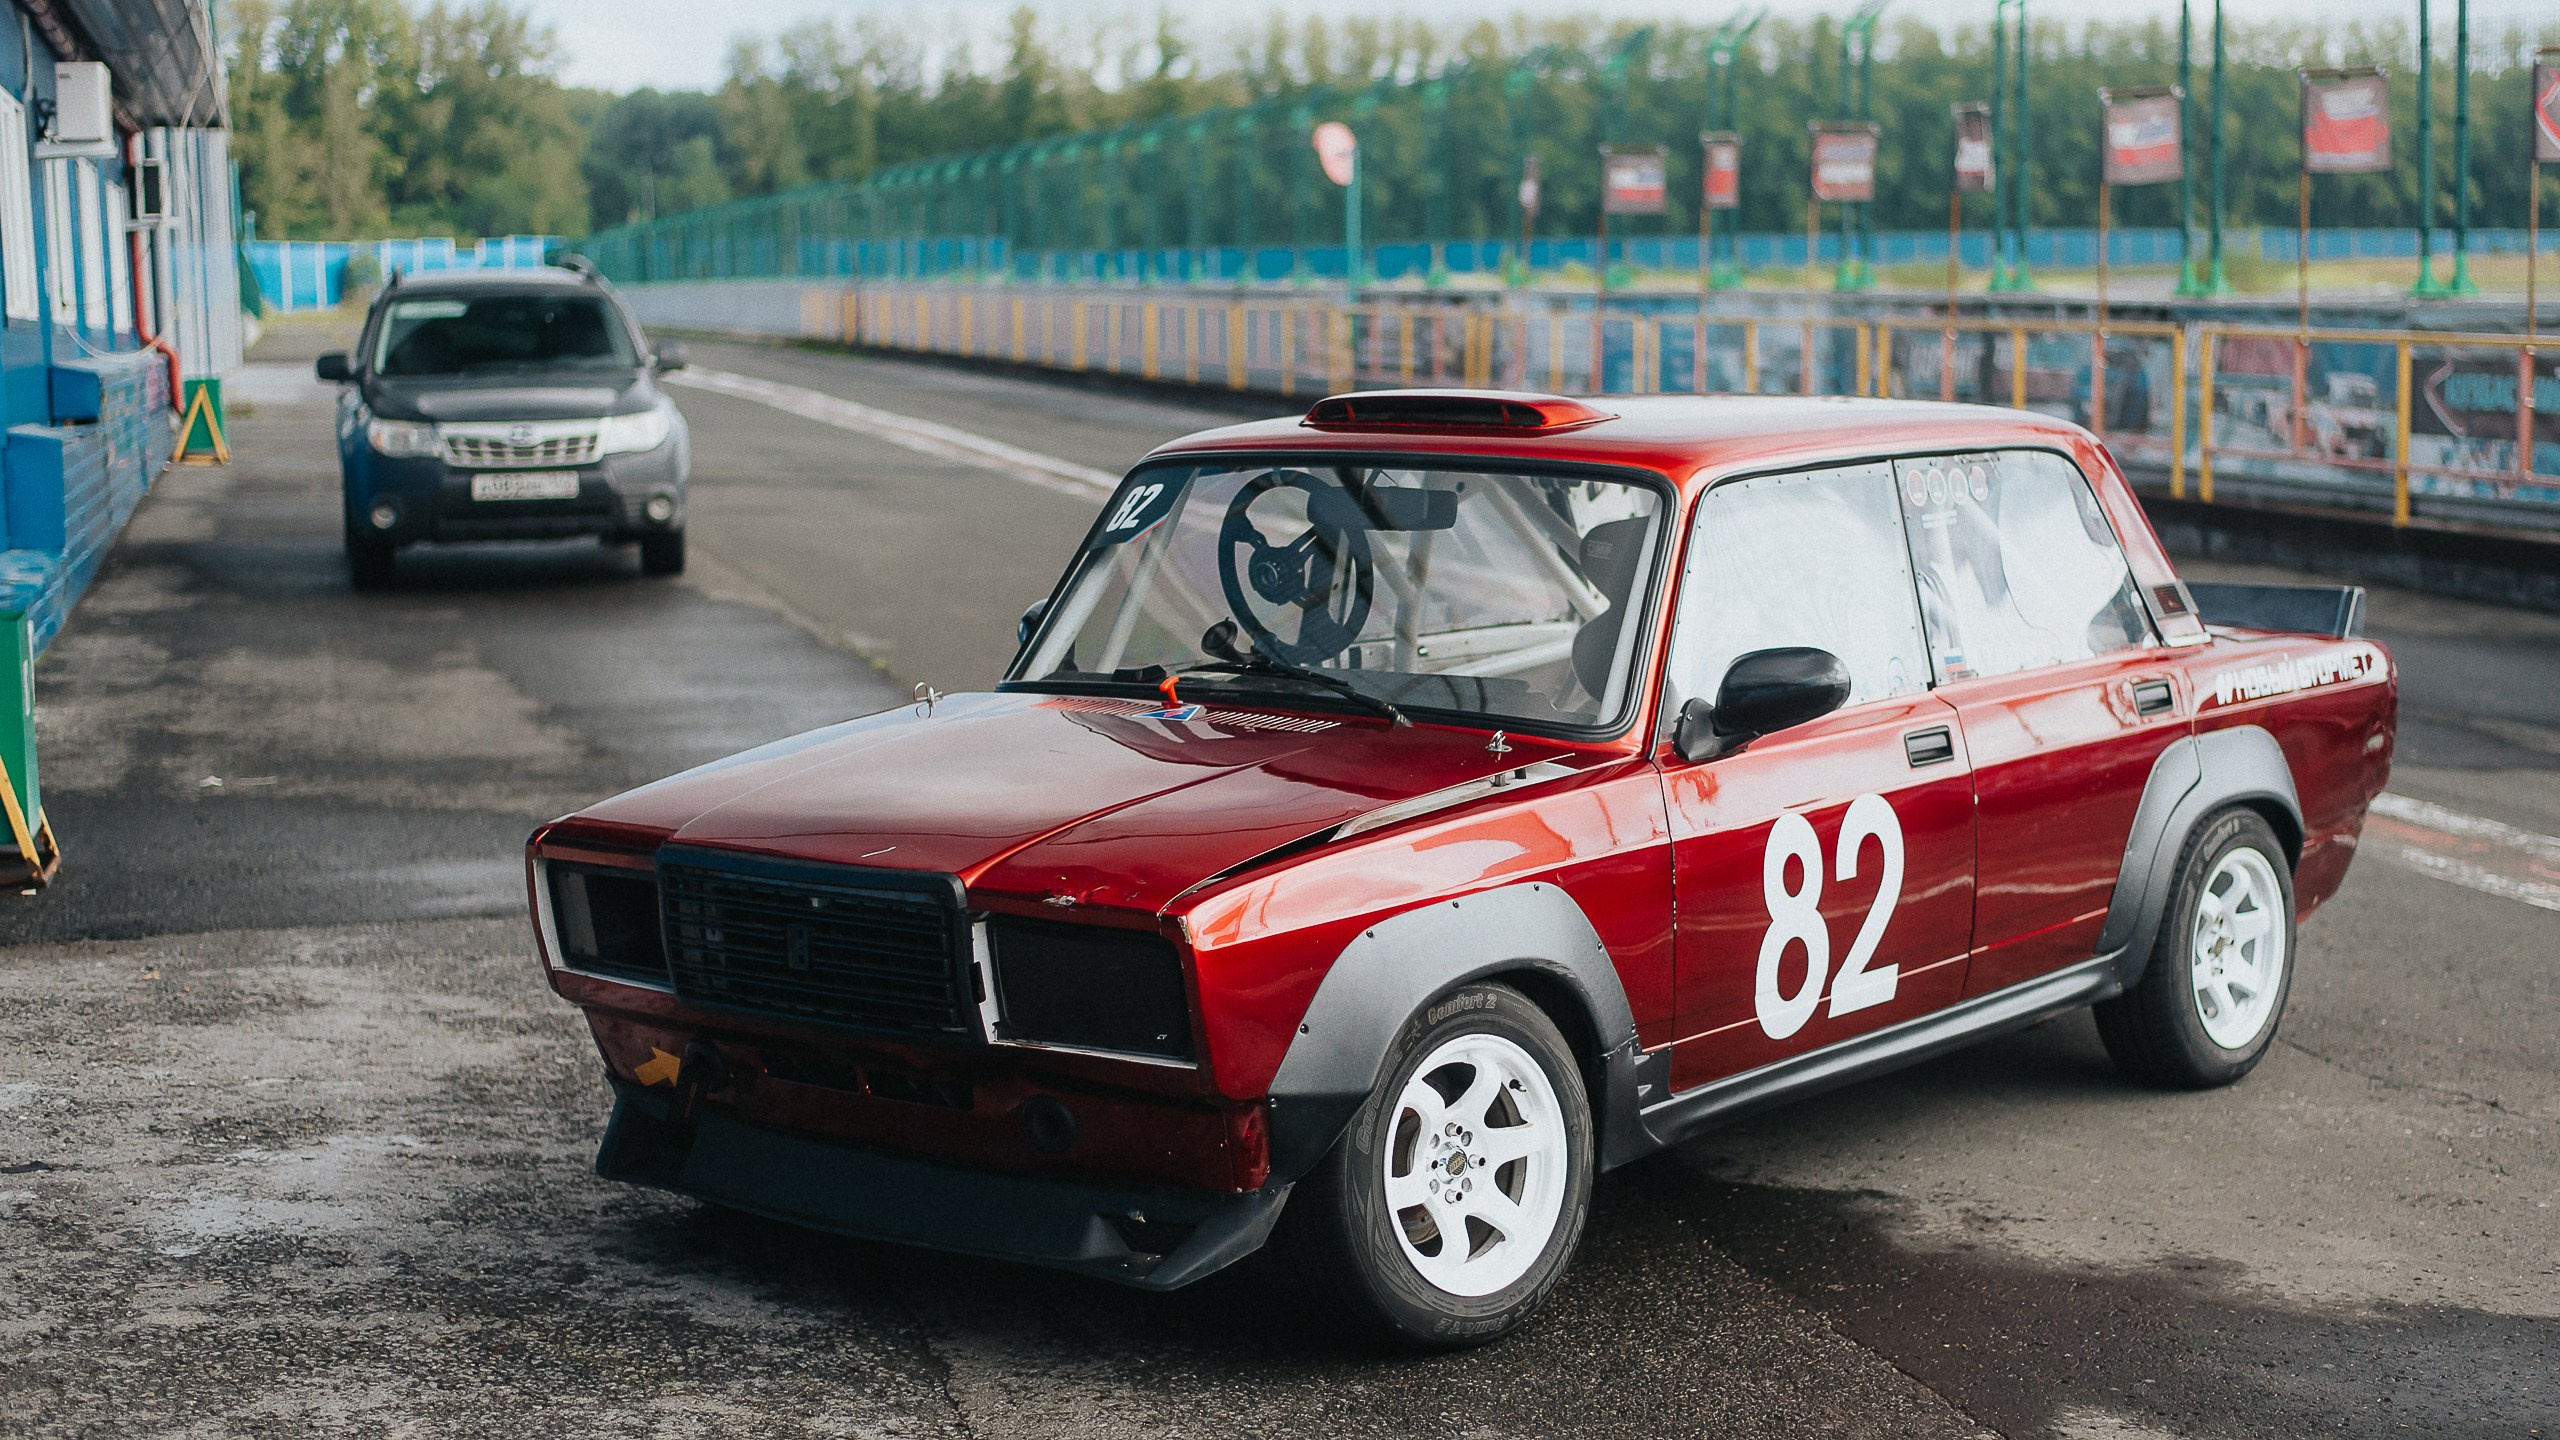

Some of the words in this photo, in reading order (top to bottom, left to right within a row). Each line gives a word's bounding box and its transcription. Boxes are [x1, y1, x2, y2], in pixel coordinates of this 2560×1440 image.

[1105, 483, 1165, 533] 82
[1754, 792, 1905, 1040] 82
[1427, 993, 1484, 1025] Comfort
[1485, 993, 1498, 1009] 2
